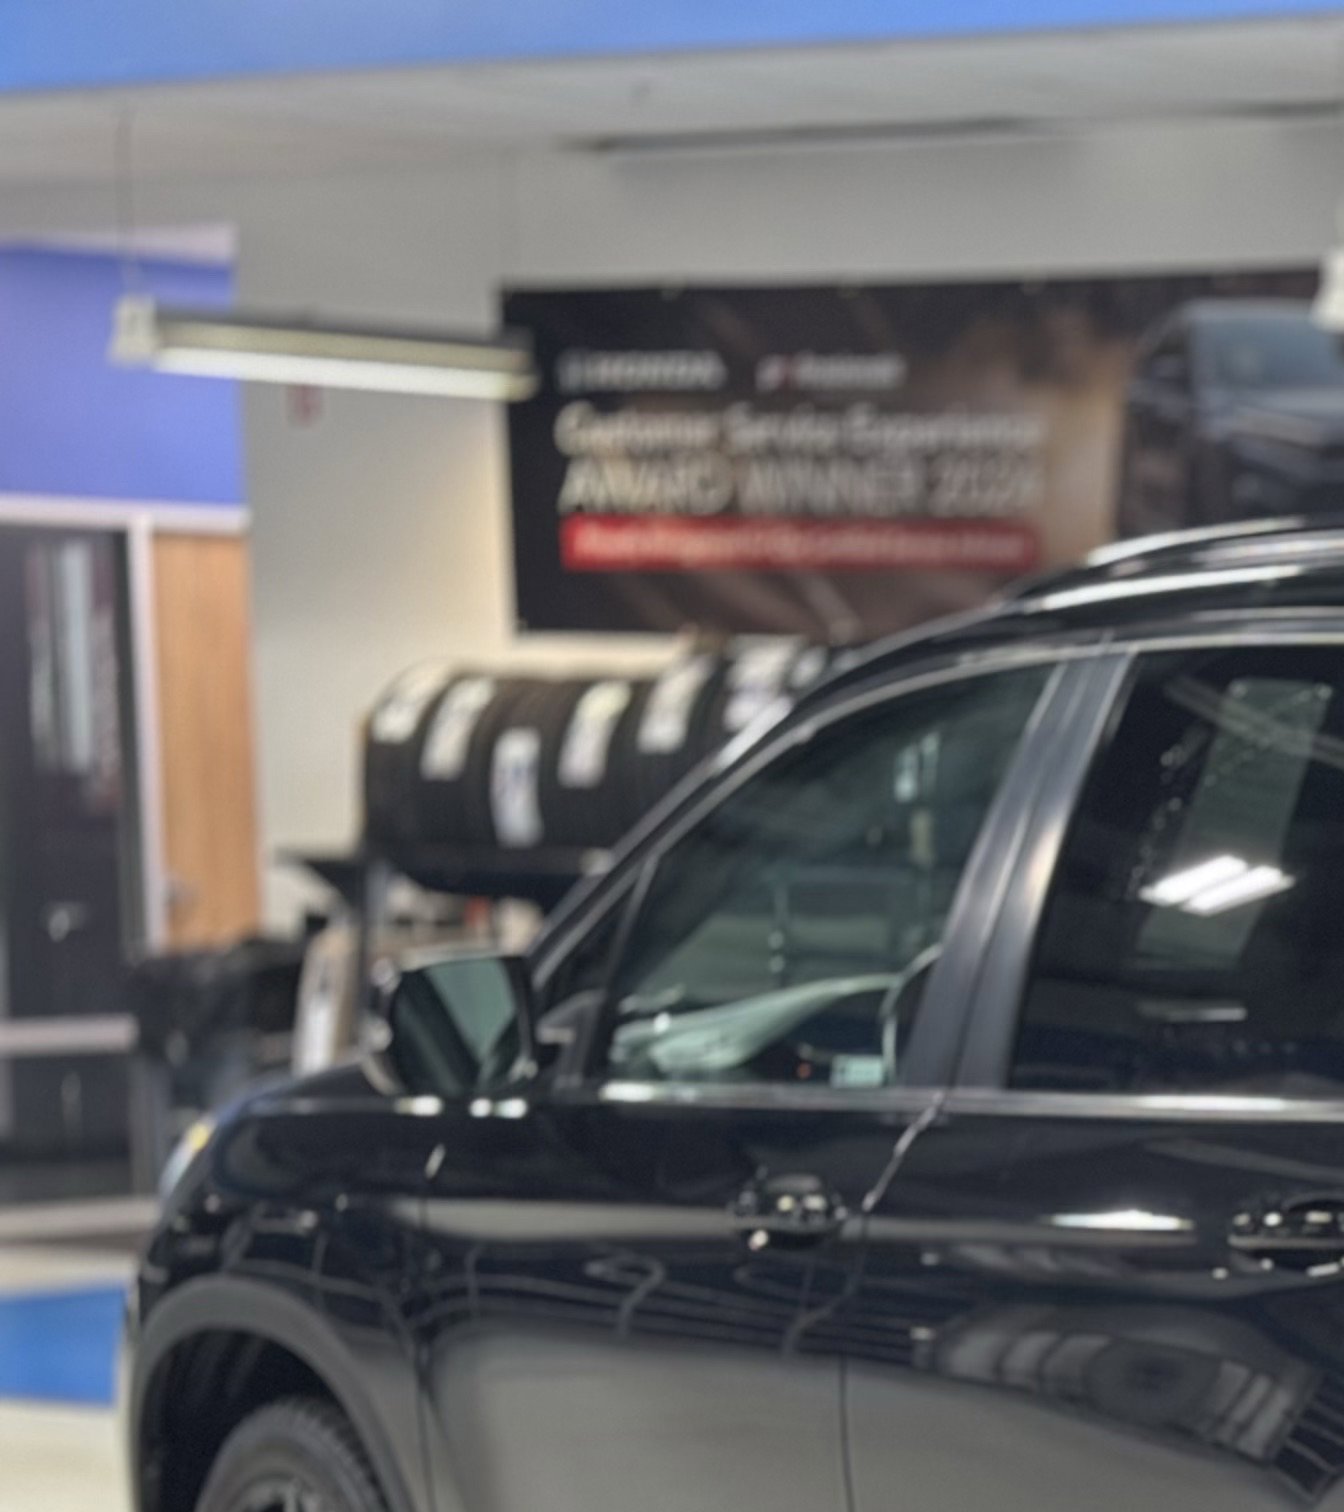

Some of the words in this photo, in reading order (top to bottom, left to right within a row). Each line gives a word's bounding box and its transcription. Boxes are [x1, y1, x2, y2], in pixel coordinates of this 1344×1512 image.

[726, 404, 838, 450] Service
[560, 459, 730, 511] AWARD
[739, 459, 922, 511] WINNER
